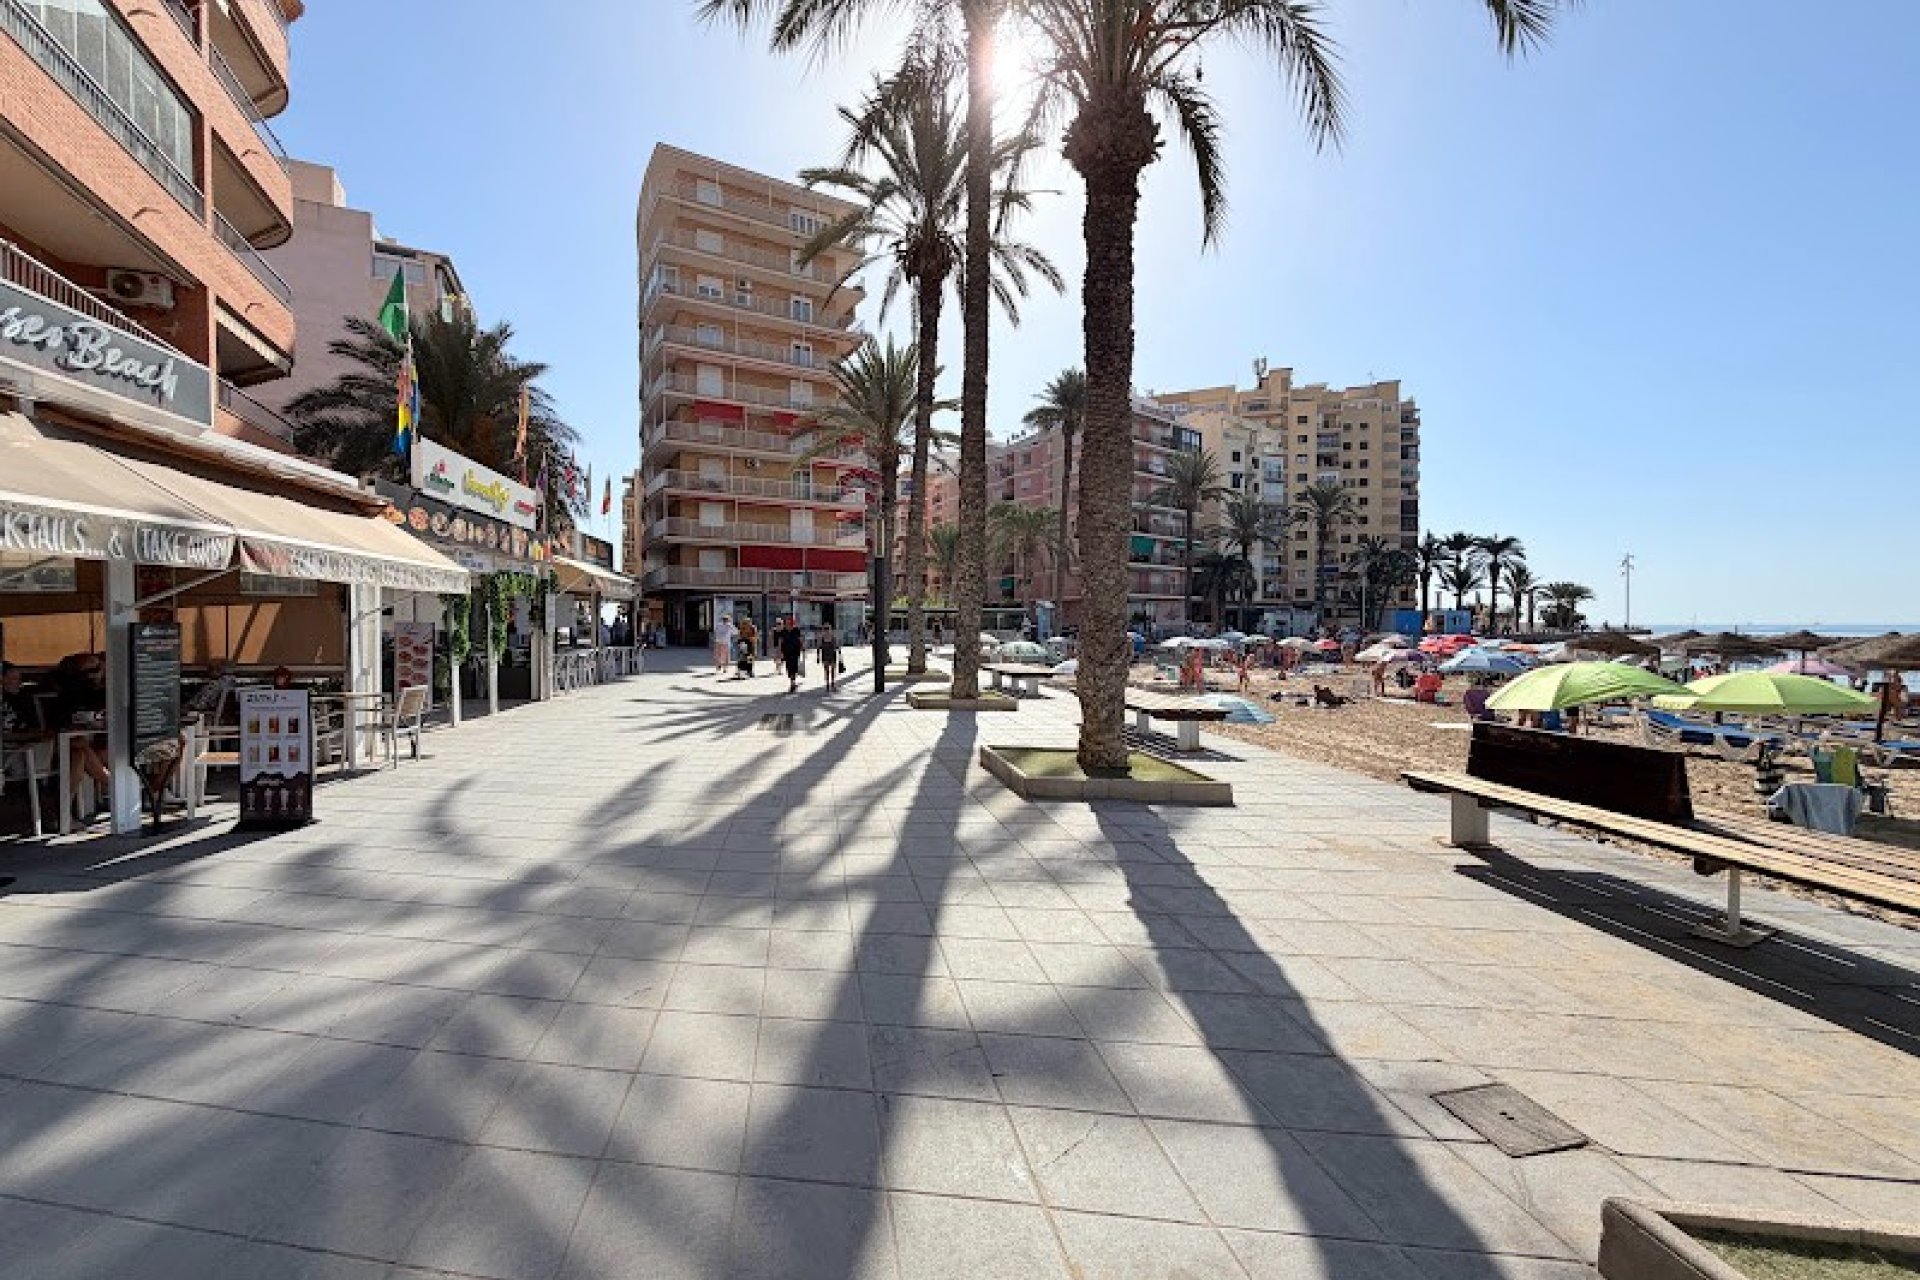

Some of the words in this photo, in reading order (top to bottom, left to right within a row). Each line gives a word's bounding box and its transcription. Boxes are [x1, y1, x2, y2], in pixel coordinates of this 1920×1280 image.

[68, 321, 178, 400] Beach
[0, 511, 105, 556] KTAILS...
[107, 526, 126, 559] &
[141, 528, 185, 563] TAKE
